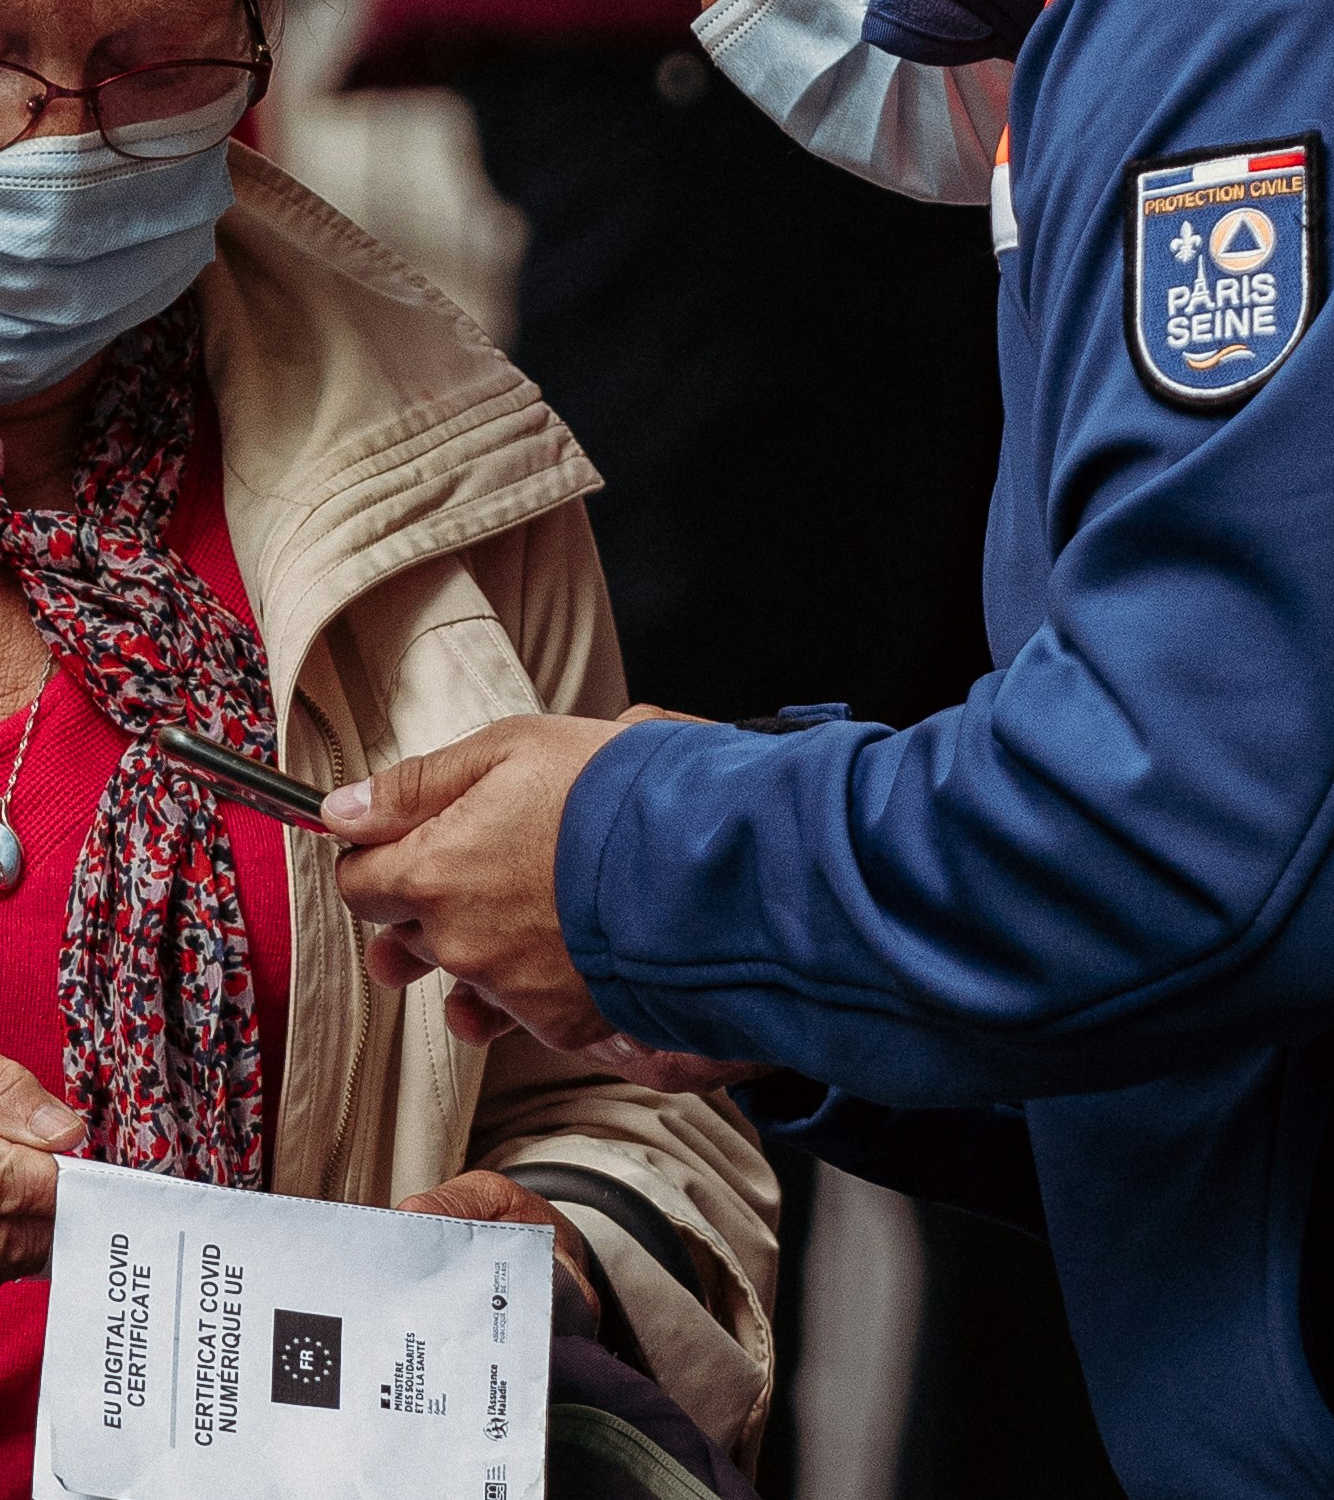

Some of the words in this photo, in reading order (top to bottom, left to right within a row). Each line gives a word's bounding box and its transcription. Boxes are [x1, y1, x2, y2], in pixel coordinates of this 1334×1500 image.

[1144, 184, 1245, 216] PROTECTION
[1250, 175, 1303, 198] CIVILE
[1168, 254, 1276, 317] PARIS
[1167, 305, 1276, 349] SEINE
[107, 1233, 130, 1303] COVID
[199, 1243, 221, 1314] COVID
[224, 1264, 244, 1295] UE
[103, 1309, 126, 1396] DIGITAL
[126, 1264, 151, 1408] CERTIFICATE
[415, 1340, 426, 1372] SANTÉ
[215, 1301, 242, 1434] NUMÉRIQUE
[299, 1349, 314, 1370] FR
[404, 1331, 415, 1393] SOLIDARITÉS
[415, 1373, 425, 1386] LA
[194, 1318, 217, 1447] CERTIFICAT
[393, 1360, 404, 1412] MINISTÈRE
[404, 1394, 414, 1413] DES
[415, 1387, 424, 1401] DE
[497, 1380, 507, 1416] Maladie
[103, 1400, 122, 1430] EU
[414, 1402, 424, 1414] ET
